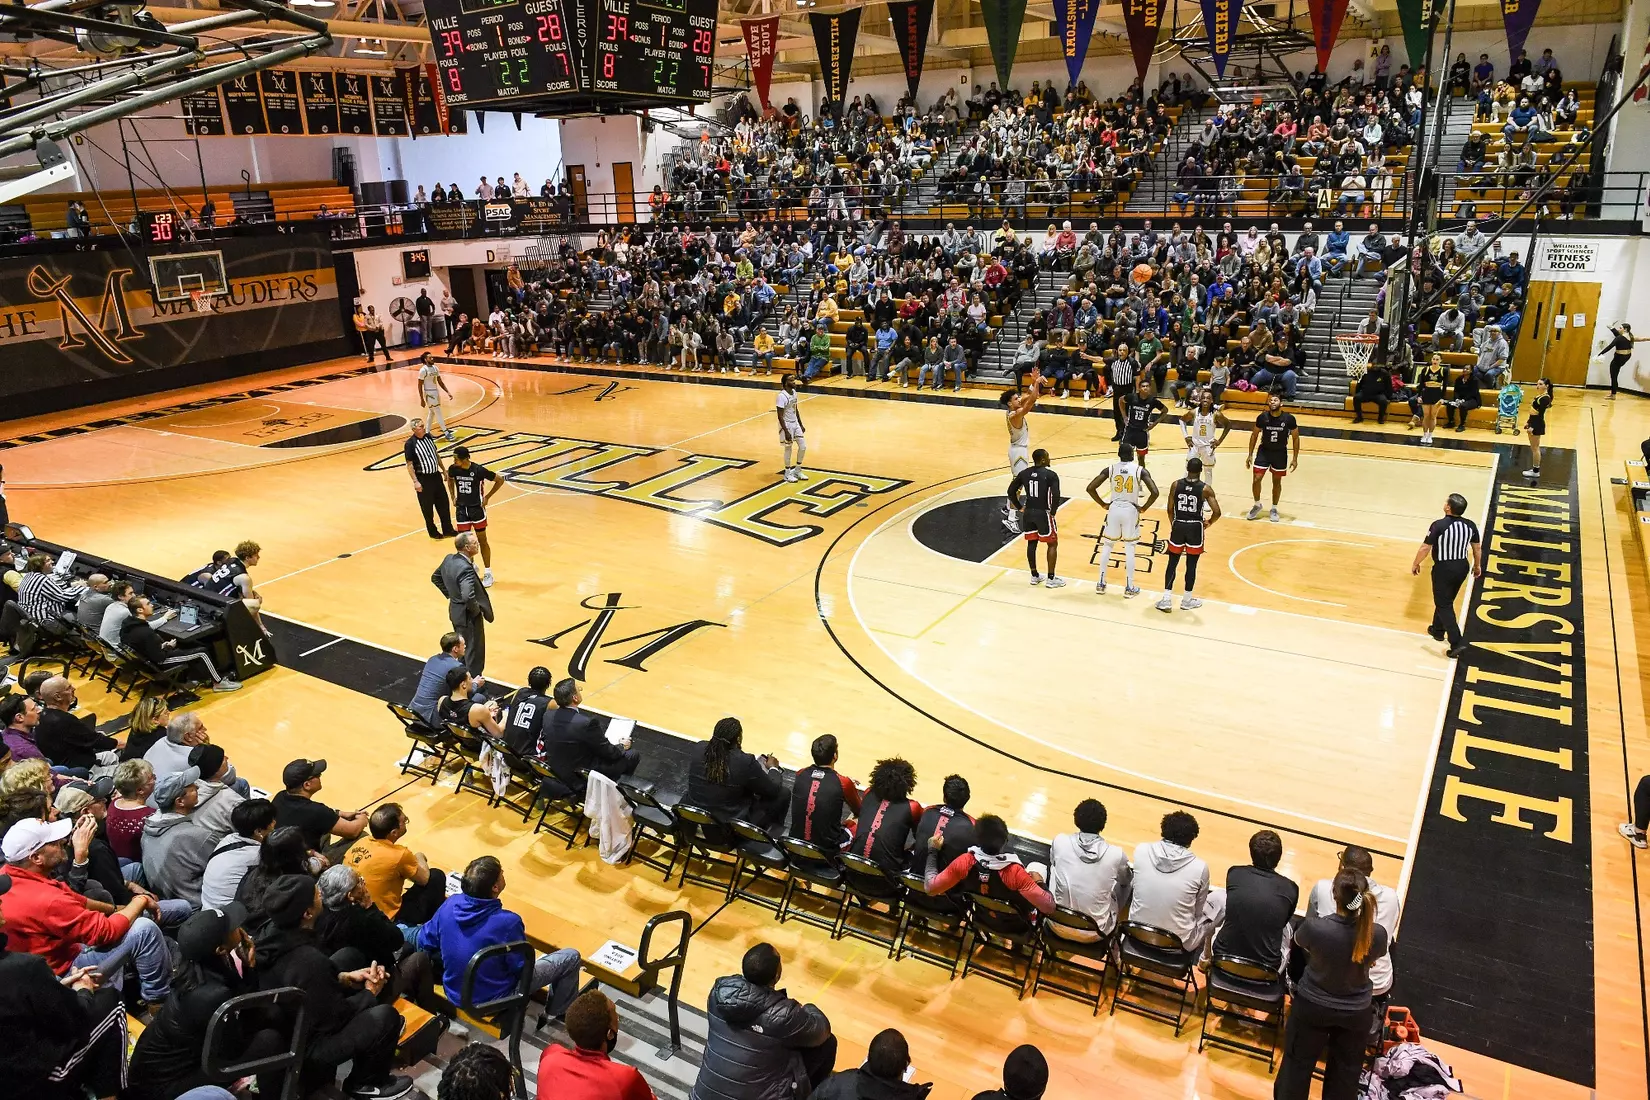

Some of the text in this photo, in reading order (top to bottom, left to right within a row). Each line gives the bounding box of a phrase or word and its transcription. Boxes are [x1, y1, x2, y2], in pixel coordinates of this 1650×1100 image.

[525, 1, 559, 15] GUEST
[603, 0, 630, 15] VILLE
[432, 16, 459, 31] VILLE
[481, 14, 504, 26] PERIOD
[651, 14, 672, 24] PERIOD
[689, 15, 715, 29] GUEST
[508, 21, 524, 32] POSS
[536, 14, 562, 42] 28
[607, 15, 627, 41] 39
[635, 21, 649, 31] POSS
[672, 27, 685, 37] POSS
[467, 28, 482, 38] POSS
[496, 25, 504, 47] 1
[661, 25, 666, 47] 1
[760, 23, 770, 55] LOCK
[440, 30, 464, 57] 39
[508, 36, 527, 46] BONUS
[635, 35, 651, 45] BONUS
[668, 40, 684, 49] BONUS
[693, 29, 712, 54] 28
[907, 6, 918, 78] MANSFIELD
[470, 42, 488, 52] BONUS
[544, 42, 567, 53] FOULS
[599, 41, 619, 52] FOULS
[750, 25, 761, 68] HAVEN
[1370, 47, 1379, 58] A
[483, 47, 529, 62] PLAYER FOUL
[644, 48, 682, 60] PLAYER FOUL
[695, 55, 712, 64] FOULS
[830, 17, 841, 101] MILLERSVILLE
[440, 58, 459, 68] FOULS
[556, 52, 569, 76] 7
[604, 53, 615, 78] 8
[448, 67, 462, 92] 8
[700, 65, 708, 88] 7
[960, 75, 968, 85] D
[546, 81, 570, 91] SCORE
[596, 79, 618, 90] SCORE
[657, 86, 677, 95] MATCH
[497, 86, 520, 97] MATCH
[692, 89, 710, 98] SCORE
[447, 93, 467, 103] SCORE
[1318, 189, 1329, 208] A
[485, 208, 511, 216] PSAC
[720, 200, 728, 213] D
[150, 223, 173, 241] 30
[410, 252, 426, 263] 3:45
[486, 249, 495, 262] D
[1547, 253, 1591, 262] FITNESS
[1550, 261, 1586, 270] ROOM
[1134, 411, 1144, 421] 13
[1199, 425, 1207, 437] 2
[1270, 431, 1278, 443] 2
[363, 425, 914, 548] VILLE
[458, 480, 472, 494] 25
[1028, 480, 1039, 498] 11
[1113, 474, 1134, 494] 34
[1177, 493, 1198, 513] 23
[1439, 483, 1575, 845] MILLERSVILLE
[512, 701, 536, 730] 12
